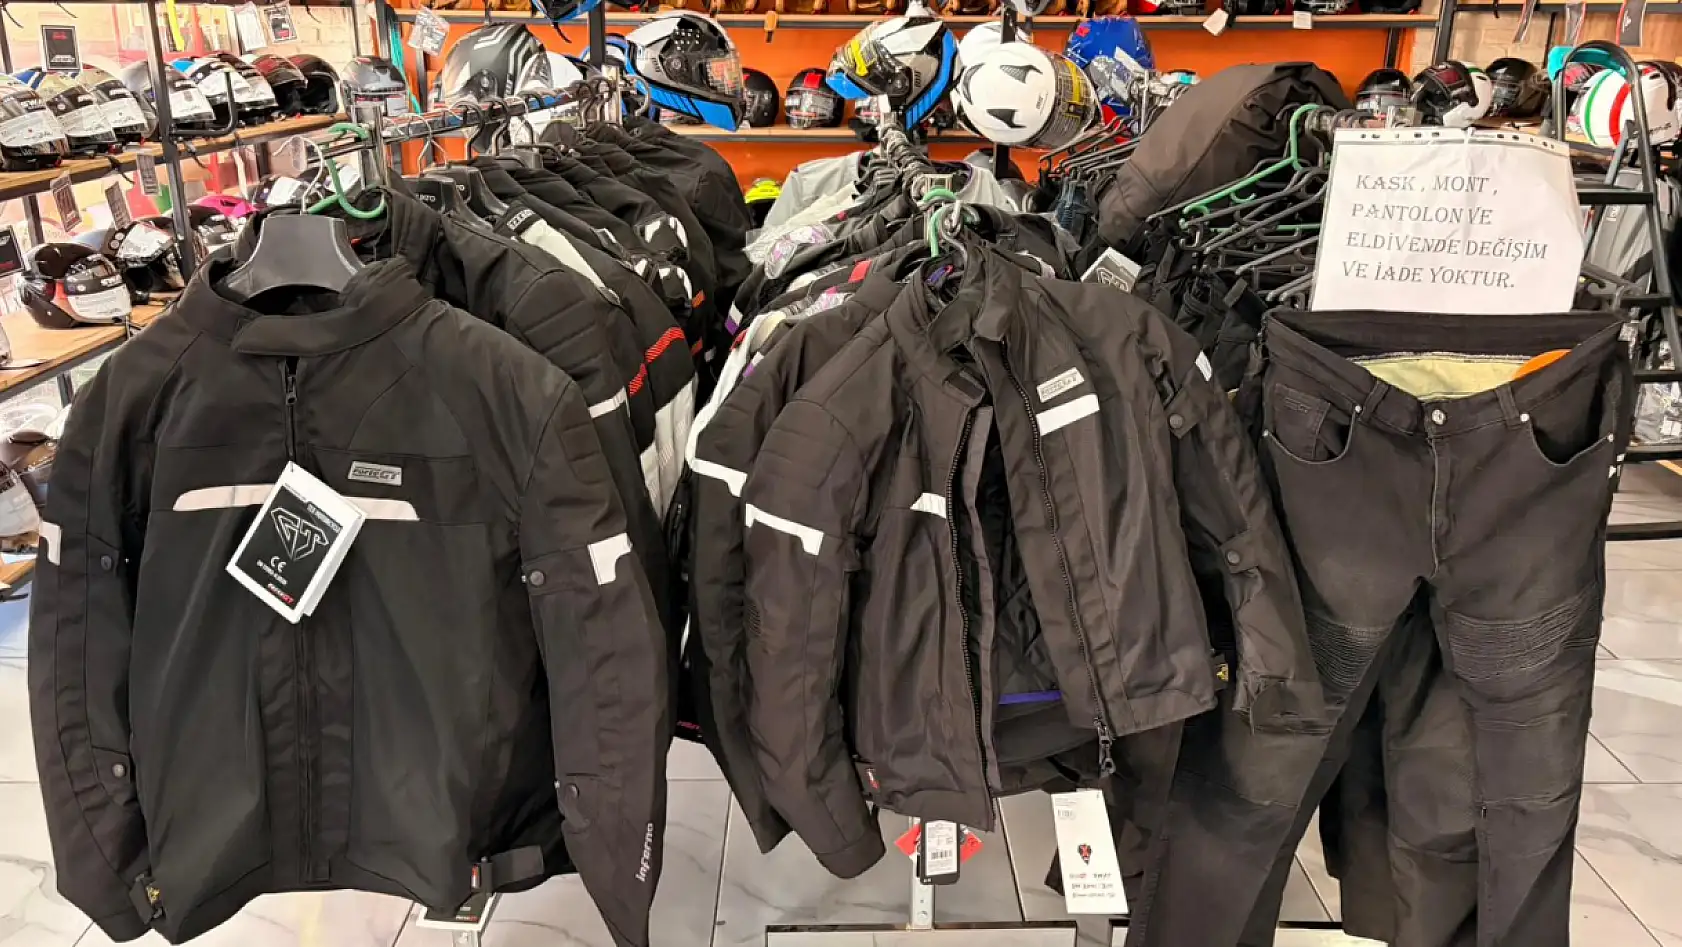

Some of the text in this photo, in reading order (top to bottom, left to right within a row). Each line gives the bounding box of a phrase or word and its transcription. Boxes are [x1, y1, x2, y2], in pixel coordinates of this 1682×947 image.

[1356, 174, 1417, 191] KASK
[1432, 175, 1491, 193] MONT
[1351, 202, 1494, 226] PANTOLON VE
[1346, 231, 1548, 263] ELDİVENDE DEĞİŞİM
[1342, 260, 1516, 289] VE İADE YOKTUR.
